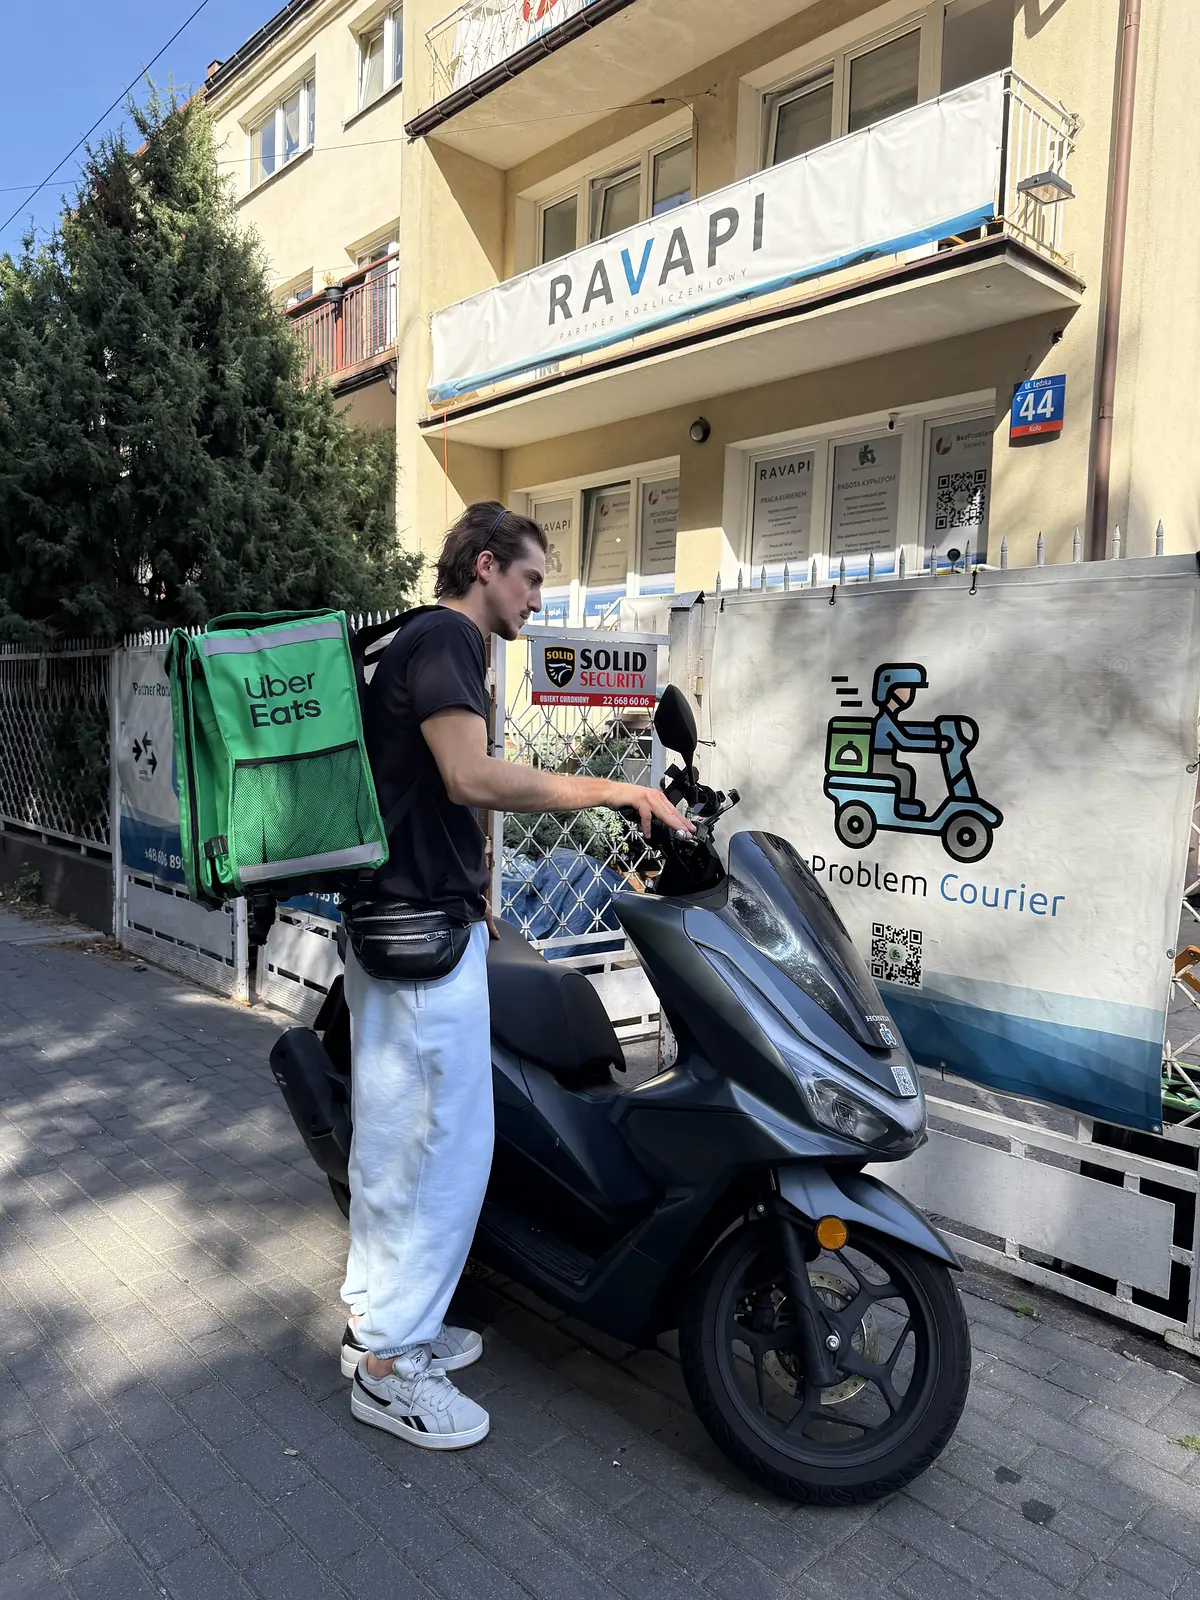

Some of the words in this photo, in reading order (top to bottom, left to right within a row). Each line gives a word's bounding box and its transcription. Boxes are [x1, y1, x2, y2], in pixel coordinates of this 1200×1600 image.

[548, 192, 765, 326] RAVAPI
[560, 315, 615, 340] PARTNER
[624, 268, 748, 318] ROZLICZENIOWY
[1020, 389, 1055, 421] 44
[760, 460, 811, 481] RAVAPI
[760, 495, 779, 504] PRACA
[779, 490, 807, 502] KURIEREM
[546, 650, 574, 661] SOLID
[580, 648, 647, 672] SOLID
[244, 672, 315, 699] Uber
[580, 671, 646, 689] SECURITY
[539, 694, 559, 703] OBIEKT
[602, 696, 613, 705] 22
[613, 696, 628, 705] 668
[629, 697, 640, 706] 60
[640, 697, 650, 706] 06
[250, 699, 322, 728] Eats
[940, 873, 1066, 917] Courier
